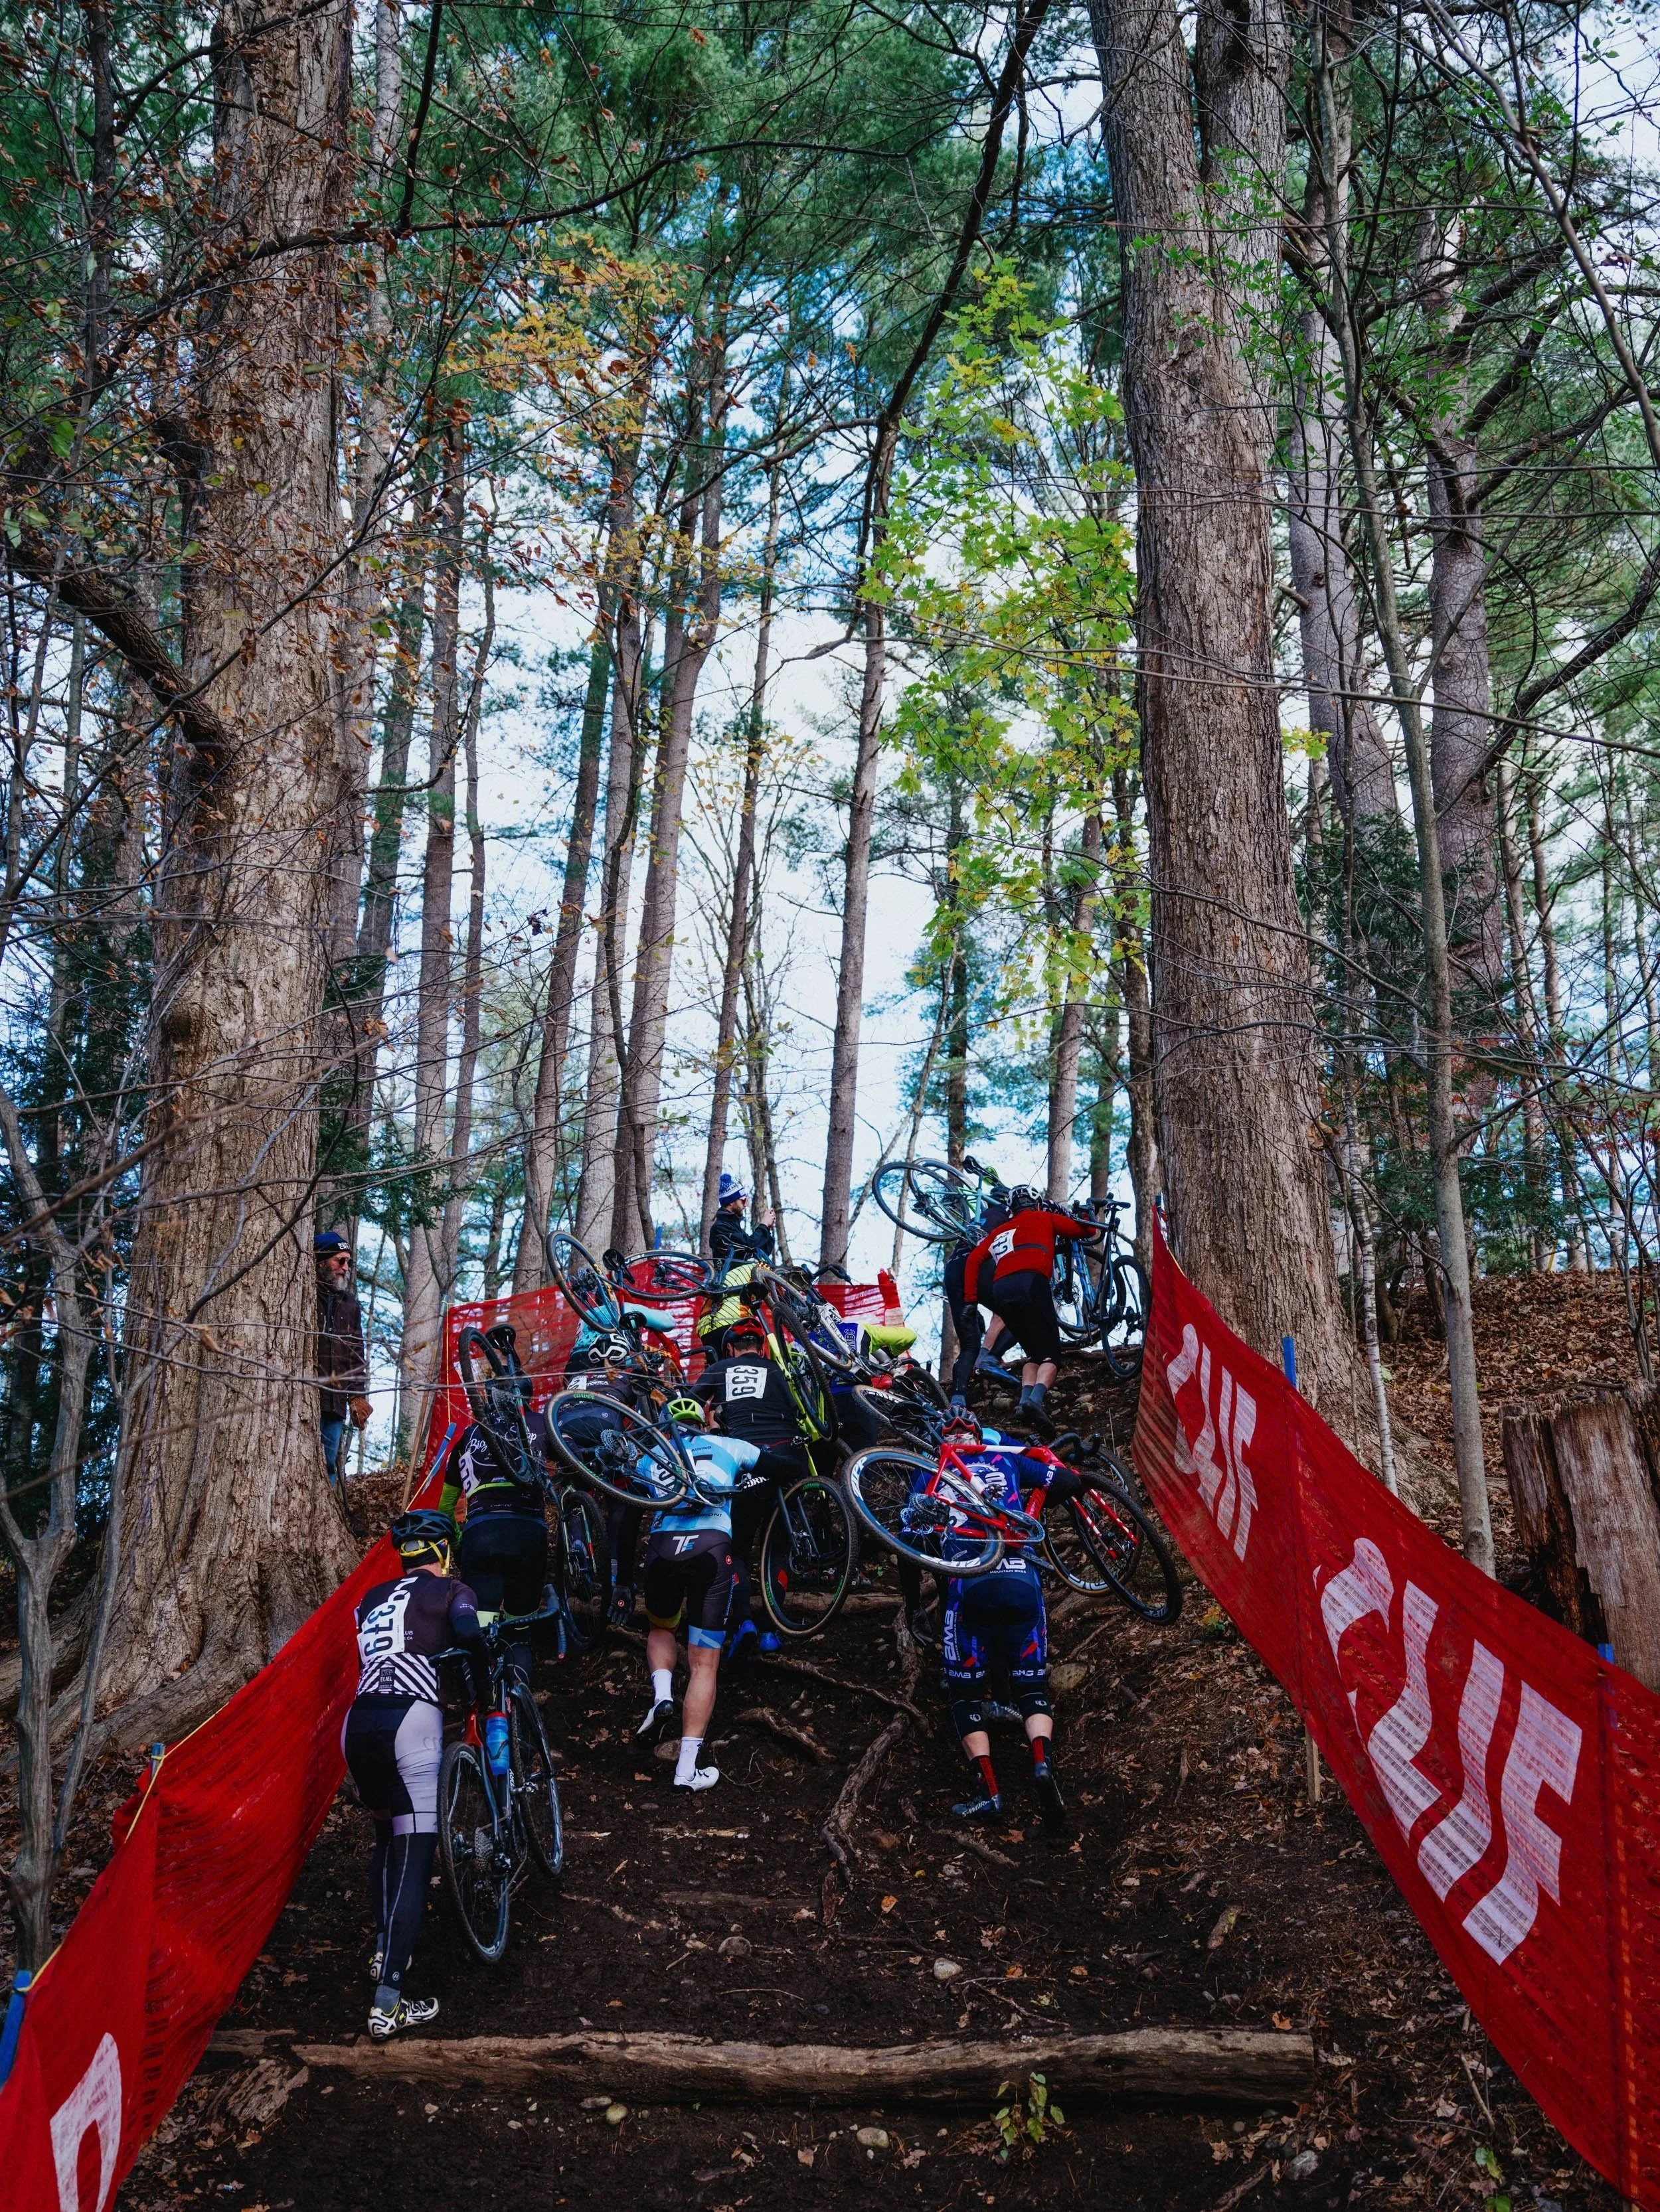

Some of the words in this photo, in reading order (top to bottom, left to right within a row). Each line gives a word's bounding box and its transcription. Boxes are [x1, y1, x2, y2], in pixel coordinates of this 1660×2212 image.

[732, 1368, 758, 1397] 359
[1167, 1323, 1258, 1563] CLIF
[364, 1605, 396, 1657] 379
[1313, 1538, 1582, 1966] CLIF
